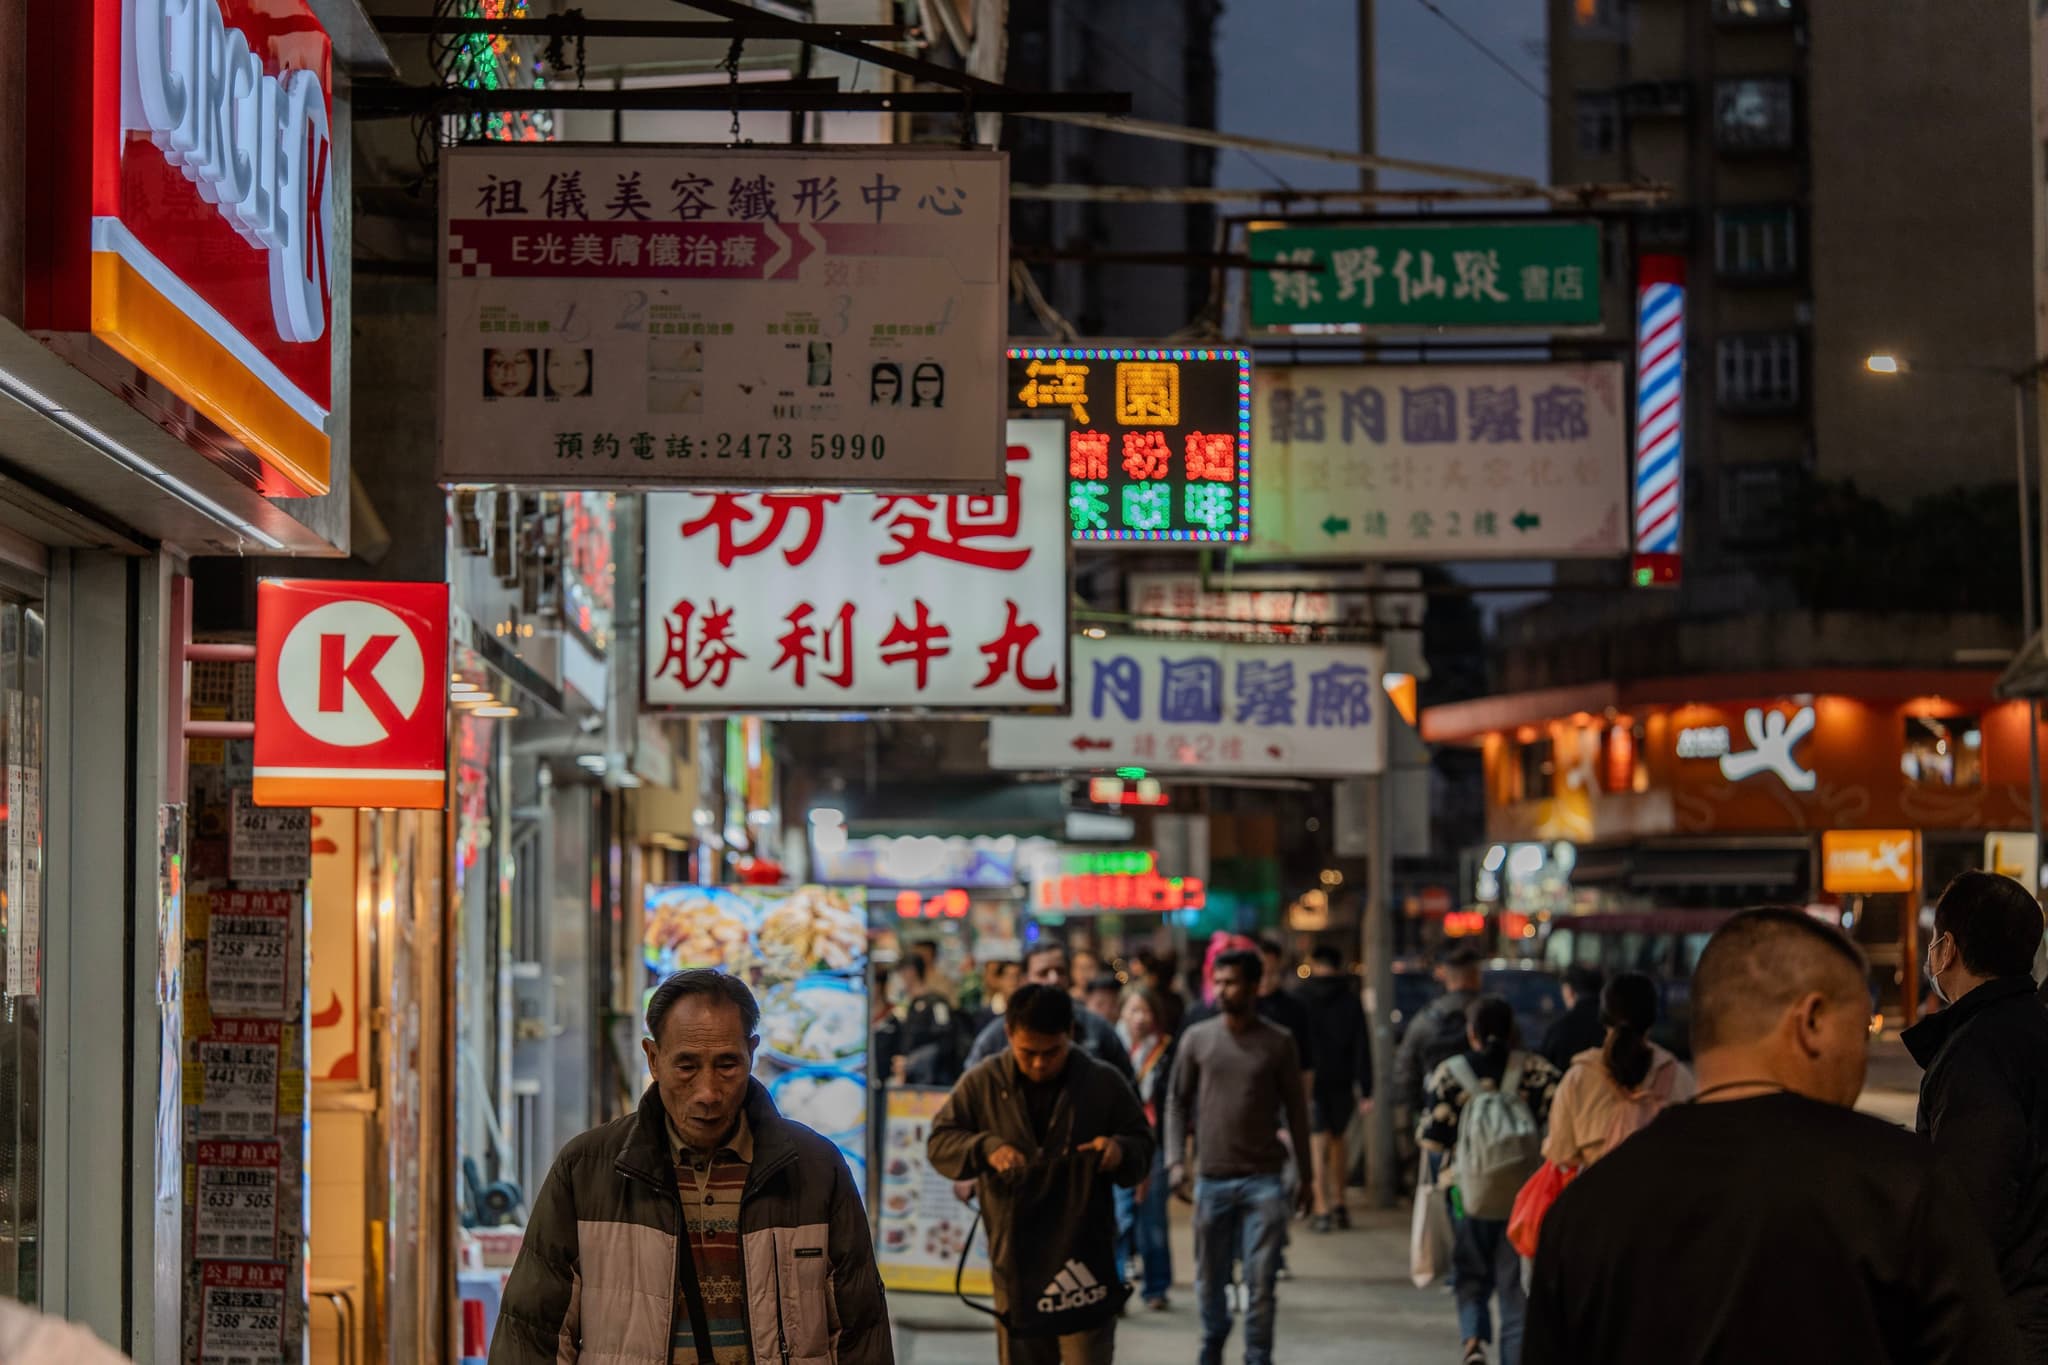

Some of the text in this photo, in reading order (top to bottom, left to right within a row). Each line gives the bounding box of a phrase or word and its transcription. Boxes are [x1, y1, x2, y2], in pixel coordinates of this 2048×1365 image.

[135, 0, 289, 249] CIRCLE
[511, 234, 757, 267] E光美膚儀治療
[1519, 264, 1584, 301] 書店
[810, 432, 887, 461] 5990
[653, 597, 1058, 691] 勝利牛丸
[319, 633, 407, 728] K
[243, 815, 268, 831] 461
[254, 942, 283, 958] 235
[208, 1192, 273, 1209] 633 505
[213, 1313, 279, 1331] 388 288
